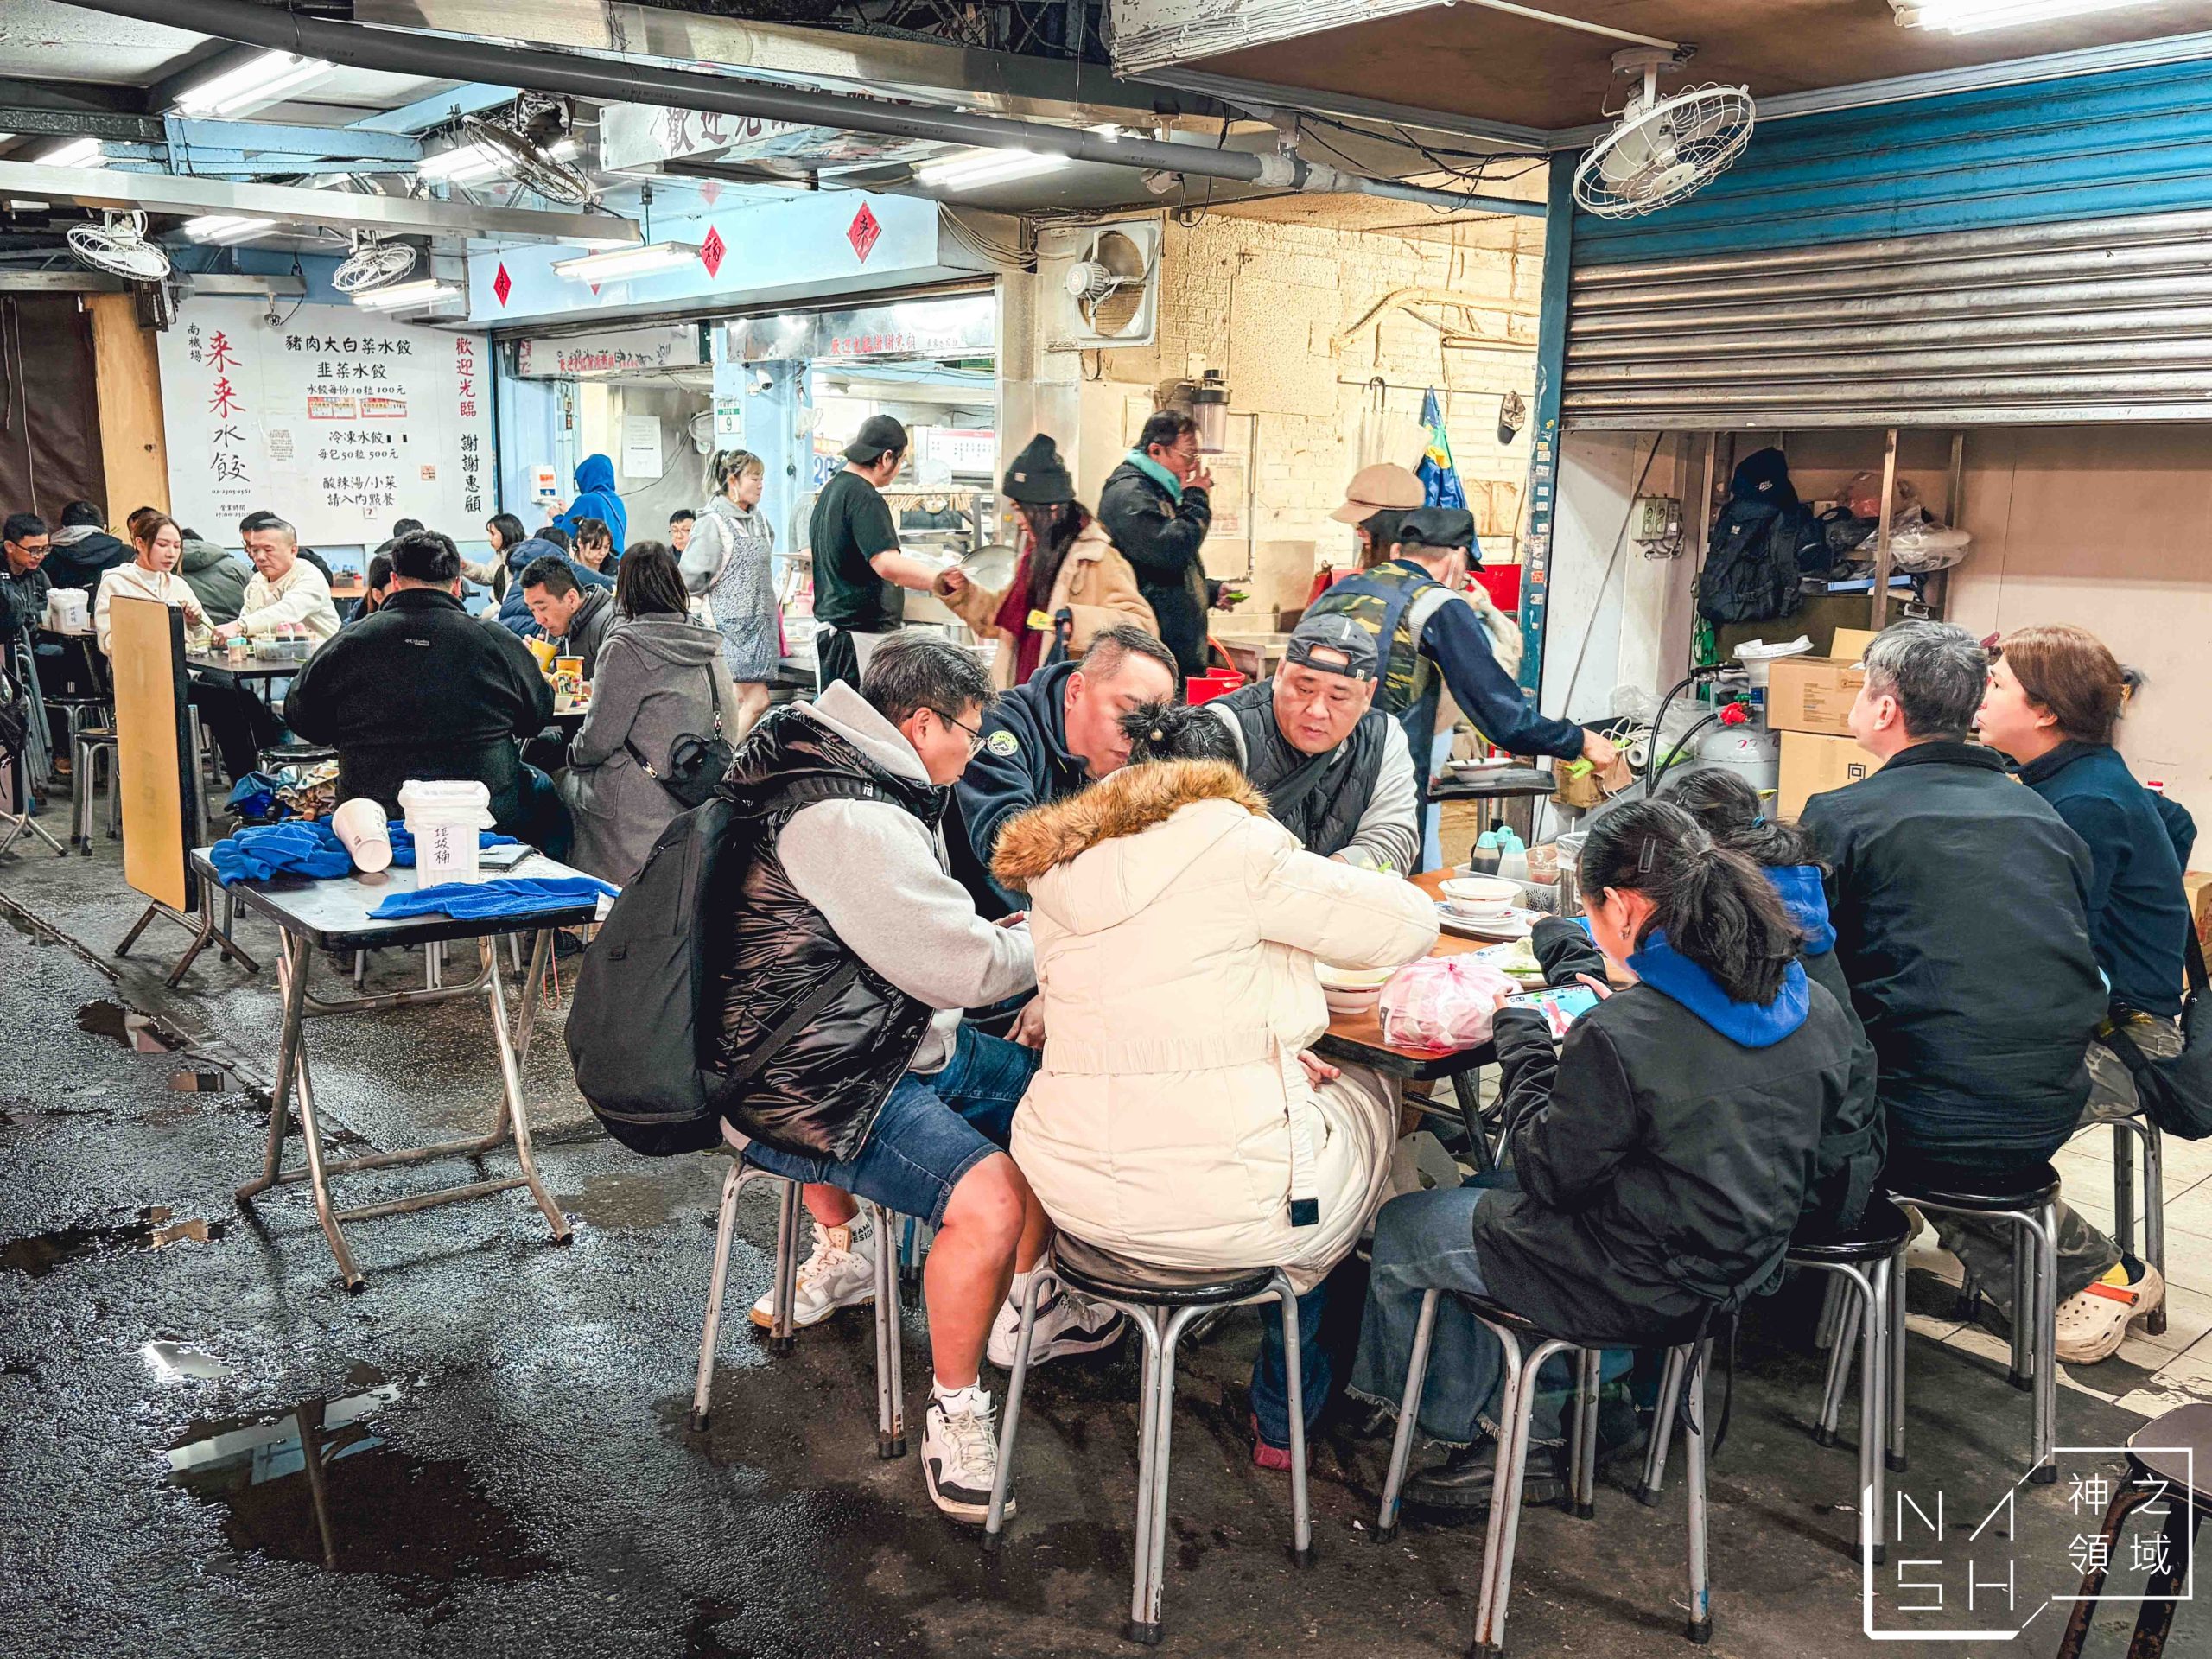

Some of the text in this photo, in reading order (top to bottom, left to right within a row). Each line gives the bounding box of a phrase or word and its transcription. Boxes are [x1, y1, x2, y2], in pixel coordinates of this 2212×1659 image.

[285, 334, 413, 356] 豬肉大白菜水餃
[317, 361, 388, 380] 韭菜水餃
[455, 337, 477, 417] 歡迎光臨
[726, 416, 733, 431] 9
[461, 434, 482, 513] 謝謝惠顧
[434, 827, 450, 864] 垃圾桶
